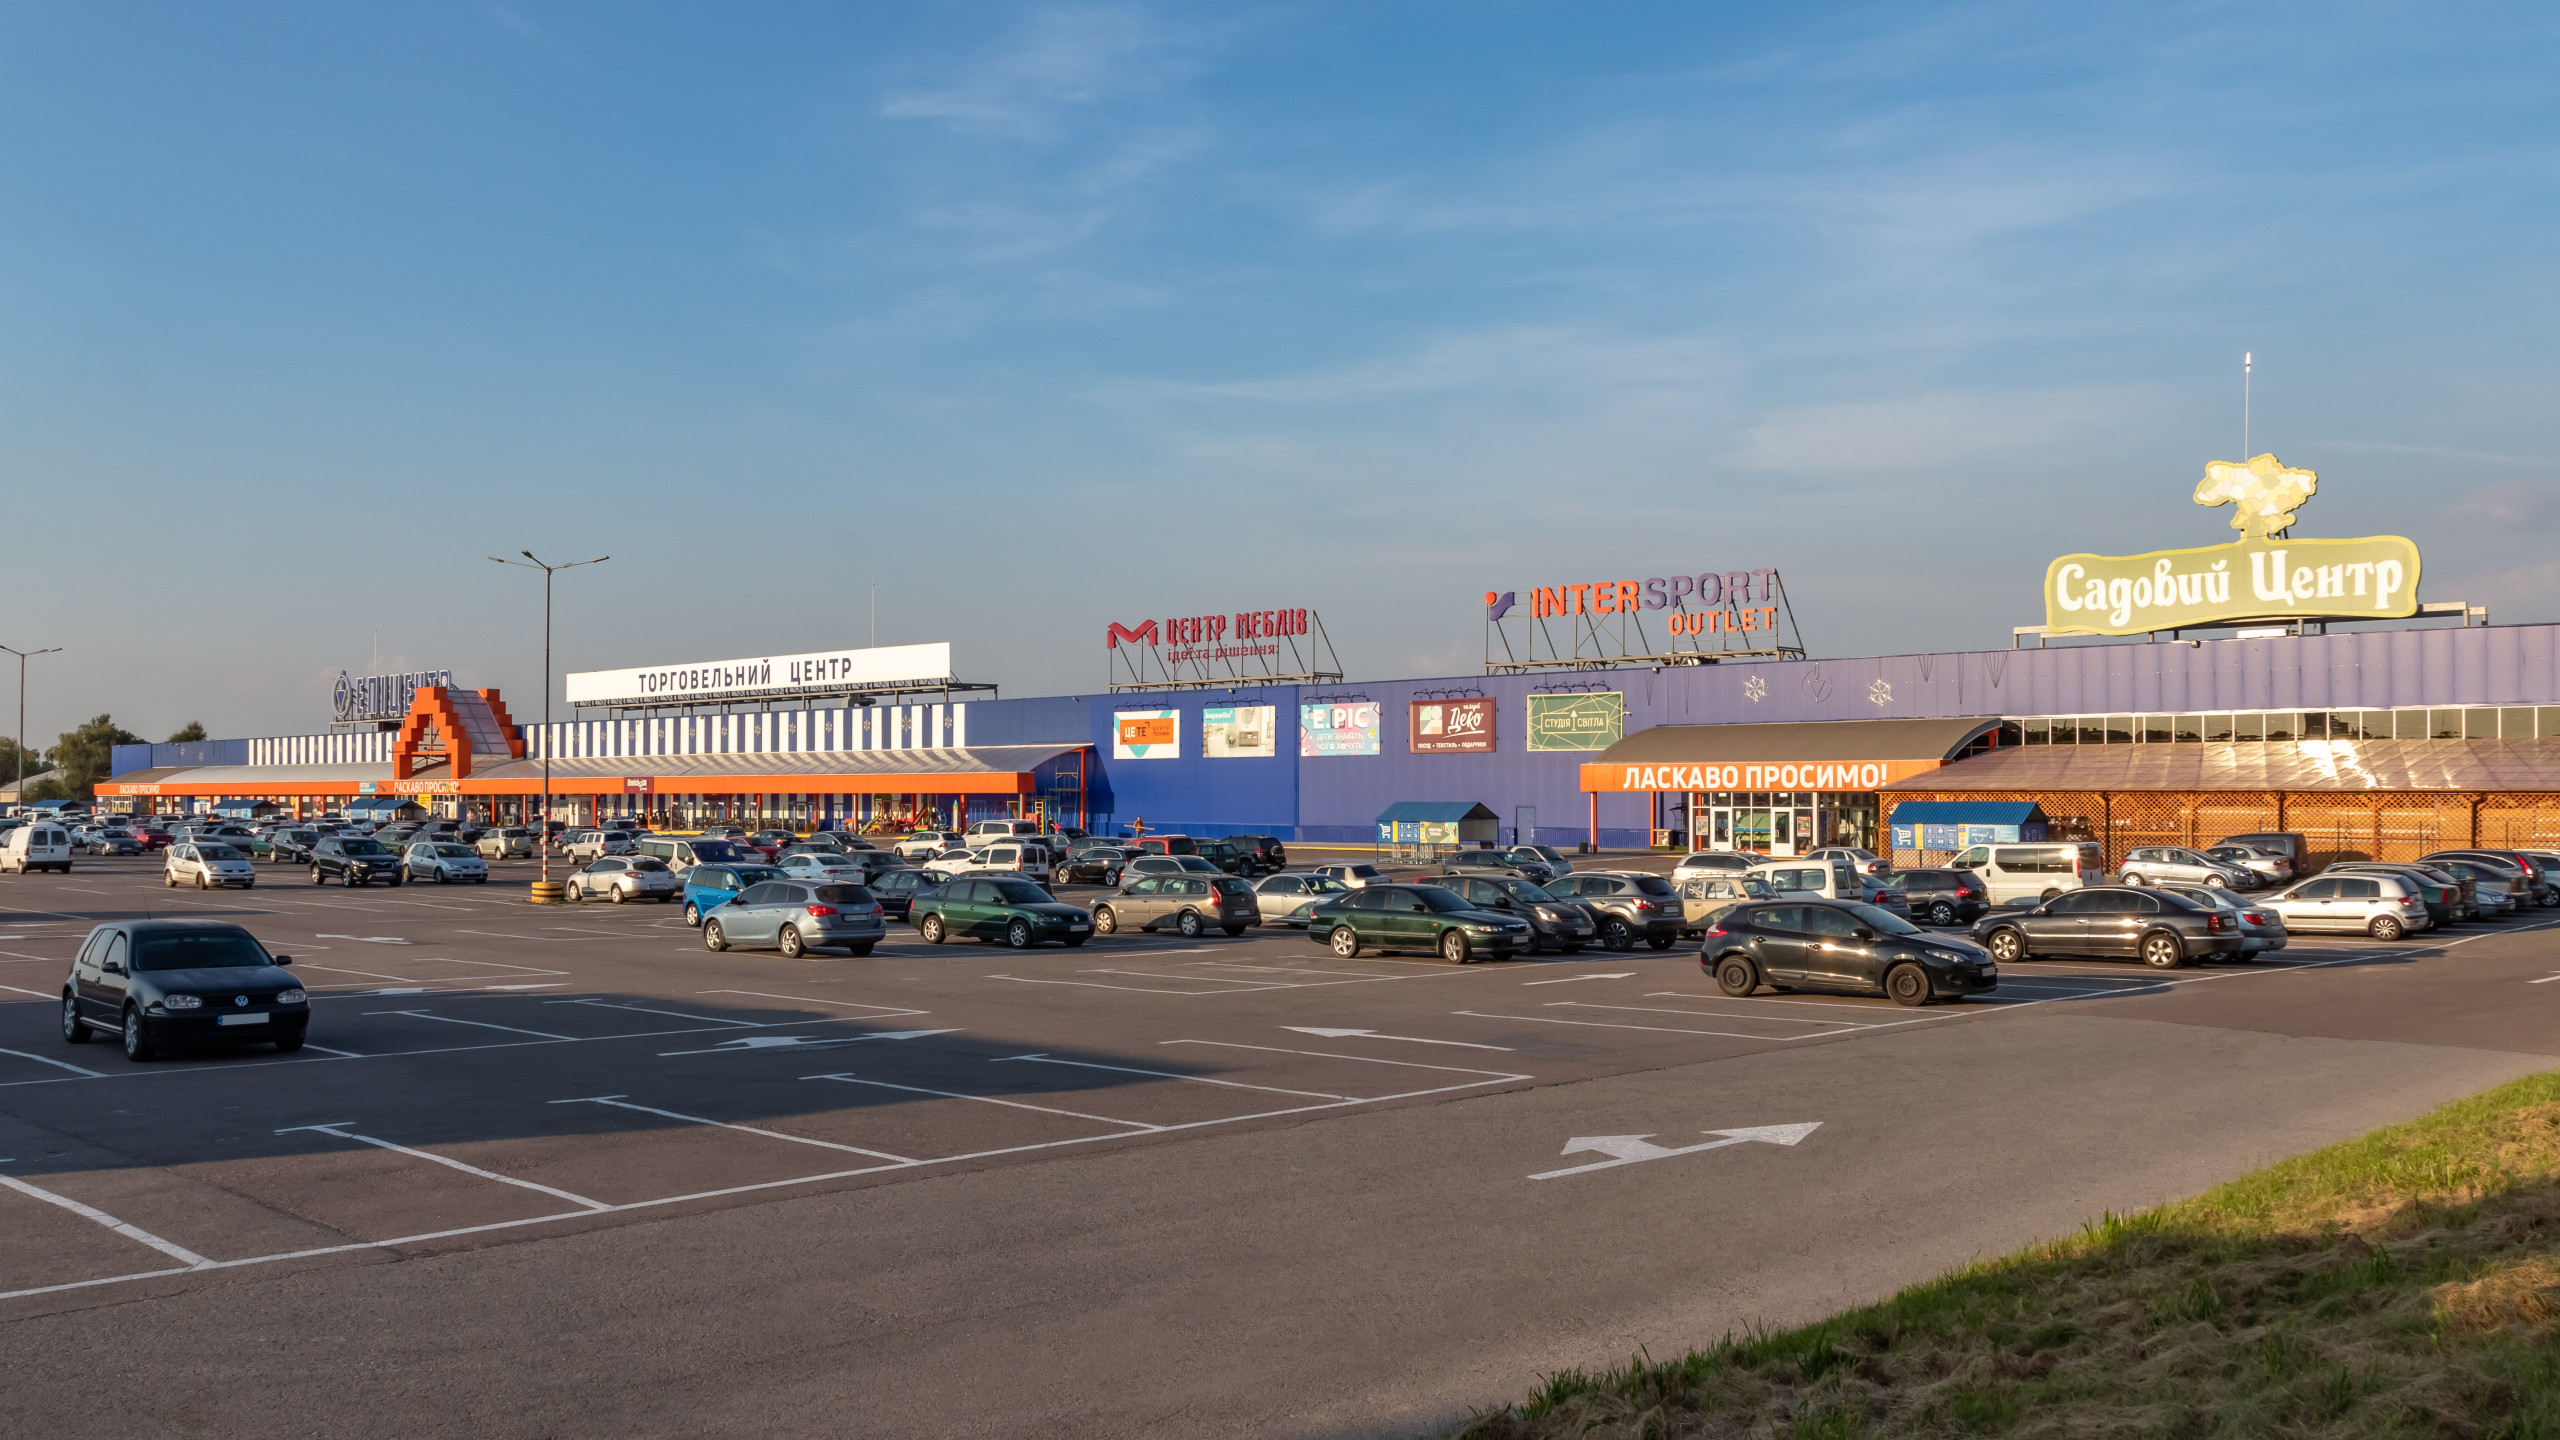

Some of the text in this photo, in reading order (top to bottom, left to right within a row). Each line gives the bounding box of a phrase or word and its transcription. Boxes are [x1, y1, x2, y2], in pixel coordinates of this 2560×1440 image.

[1532, 568, 1777, 619] INTERSPORT
[2056, 550, 2403, 627] Садовий Центр
[1166, 608, 1307, 647] ЦЕНТР МЕБЛІВ
[1668, 607, 1778, 636] OUTLET
[1167, 644, 1276, 664] ідеї та рішення
[638, 657, 852, 693] ТОРГОВЕЛЬНИЙ ЦЕНТР
[1312, 707, 1369, 729] E.PIC
[1447, 707, 1481, 735] Деко
[1544, 717, 1604, 729] СТУДІЯ СВІТЛА
[1316, 733, 1333, 742] ДІТИ
[1316, 742, 1335, 751] ЧОГО
[393, 781, 424, 793] ЛАСКАВО
[1623, 763, 1888, 789] ЛАСКАВО ПРОСИМО!
